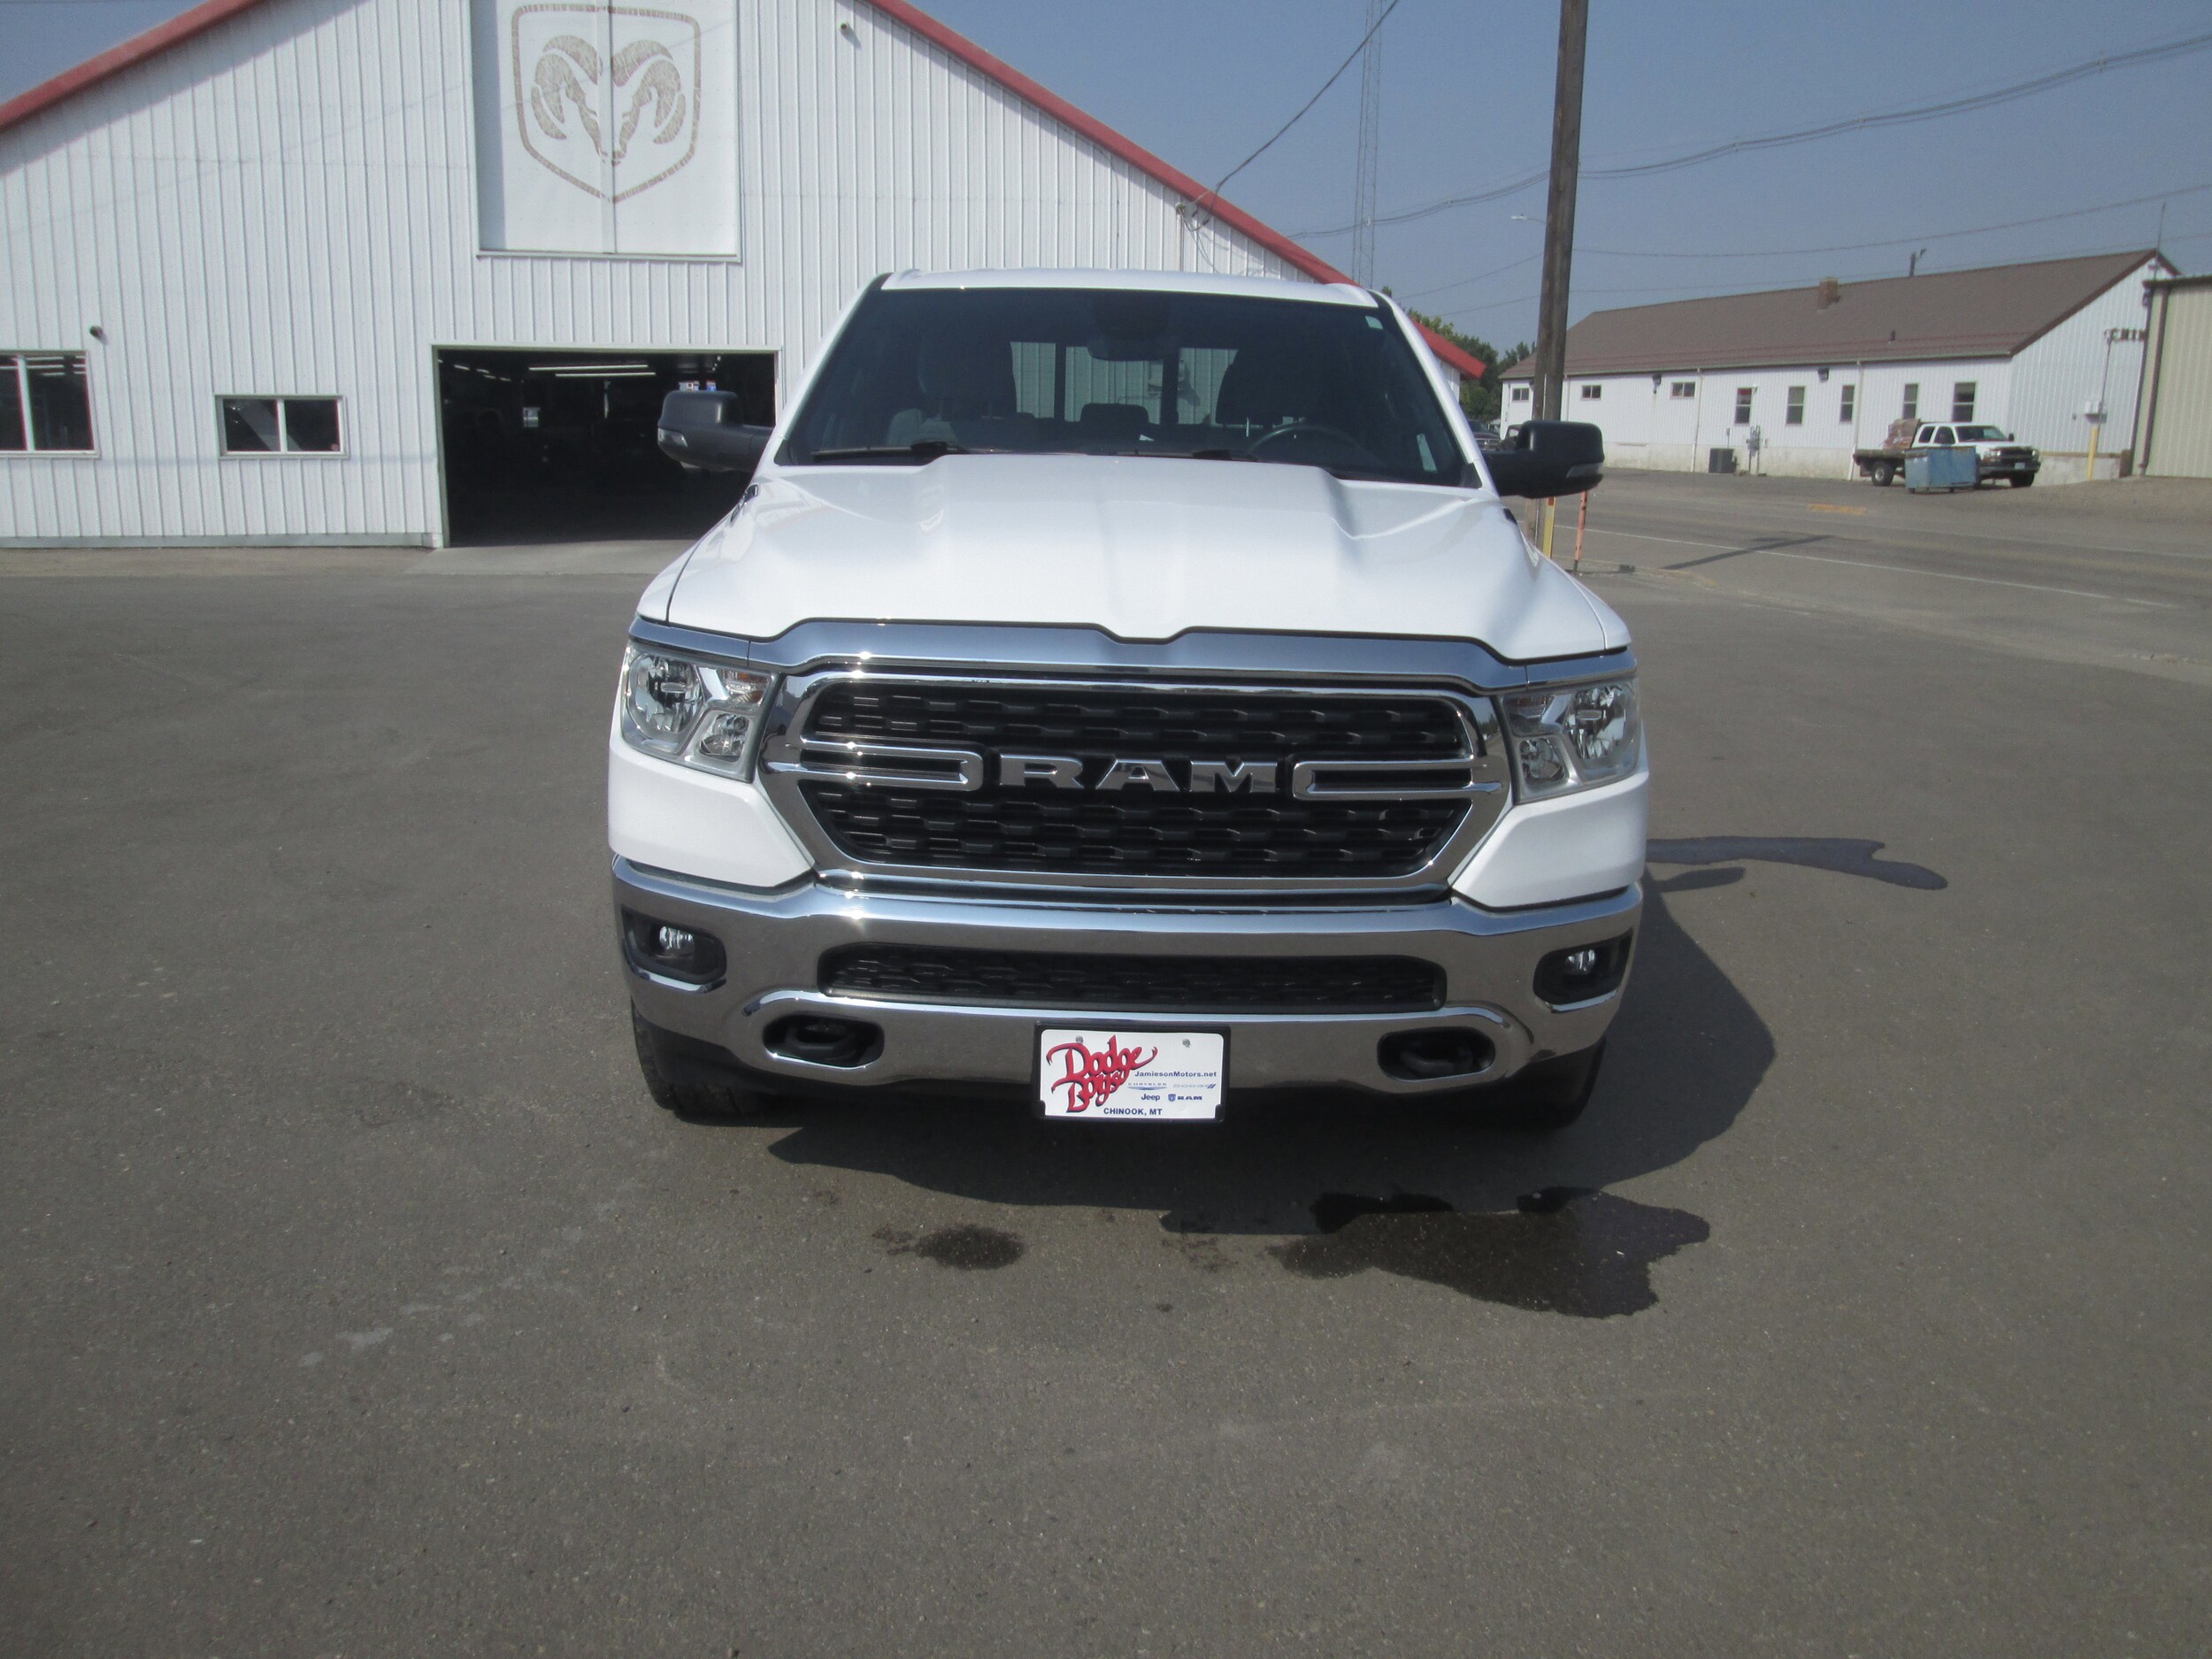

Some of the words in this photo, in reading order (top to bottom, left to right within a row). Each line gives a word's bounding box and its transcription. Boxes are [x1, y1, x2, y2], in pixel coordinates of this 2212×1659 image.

[999, 753, 1279, 793] RAM
[1046, 1034, 1158, 1078] Dodge
[1051, 1070, 1129, 1113] Boys
[1103, 1107, 1148, 1116] CHINOOK,
[1141, 1093, 1161, 1102] Jeep
